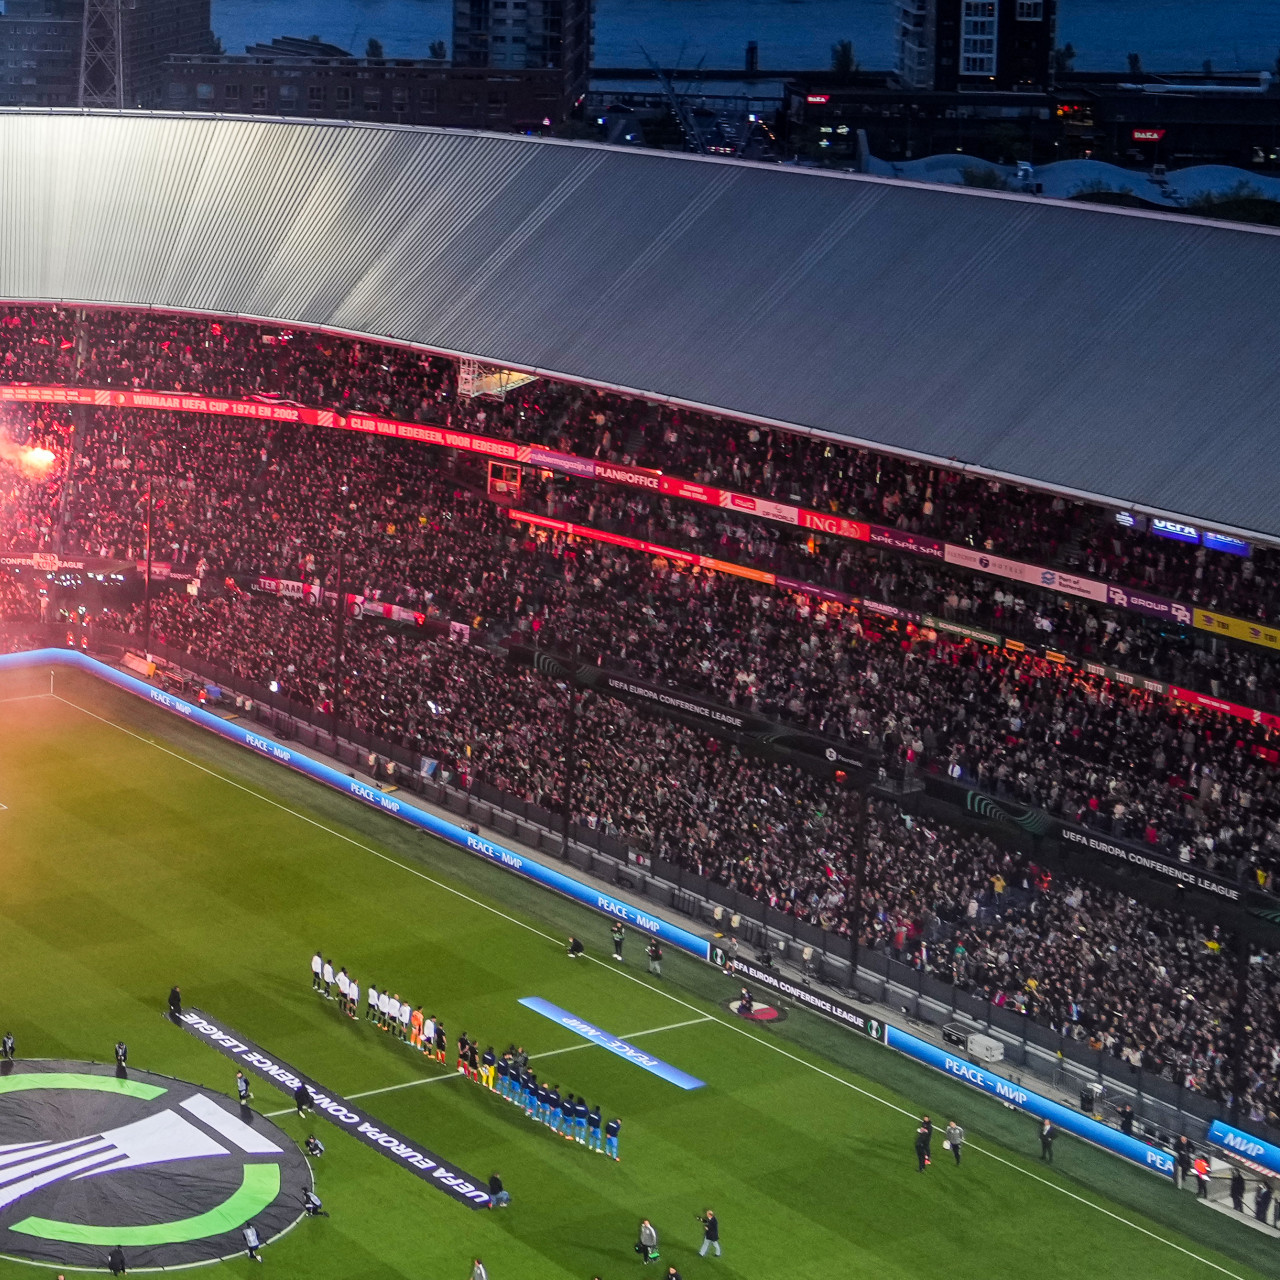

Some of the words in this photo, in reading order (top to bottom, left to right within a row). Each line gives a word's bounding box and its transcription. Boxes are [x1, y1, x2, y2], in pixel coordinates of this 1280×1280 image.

[133, 395, 181, 408] WINNAAR
[182, 398, 207, 411] UEFA
[209, 401, 229, 413] CUP
[232, 403, 256, 416] 1974
[258, 406, 272, 418] EN
[273, 408, 299, 420] 2002
[351, 417, 376, 430] CLUB
[377, 422, 396, 434] VAN
[446, 433, 470, 449] VOOR
[472, 438, 516, 458] IEDEREEN
[805, 514, 837, 534] ING
[1130, 596, 1169, 612] GROUP
[150, 689, 171, 707] PEACE
[608, 678, 629, 692] UEFA
[629, 684, 658, 701] EUROPA
[659, 694, 710, 717] CONFERENCE
[711, 710, 743, 728] LEAGUE
[245, 733, 268, 752] PEACE
[350, 782, 375, 802] PEACE
[467, 836, 494, 858] PEACE
[1062, 829, 1088, 846] UEFA
[1089, 838, 1127, 860] EUROPA
[1128, 852, 1196, 884] CONFERENCE
[1197, 877, 1240, 901] LEAGUE
[598, 896, 628, 920] PEACE
[749, 967, 779, 989] EUROPA
[779, 981, 832, 1012] CONFERENCE
[832, 1005, 864, 1028] LEAGUE
[178, 1012, 241, 1053] LEAGUE
[607, 1039, 659, 1067] PEACE
[945, 1057, 985, 1087] PEACE
[357, 1121, 437, 1170] EUROPA
[432, 1166, 492, 1205] UEFA
